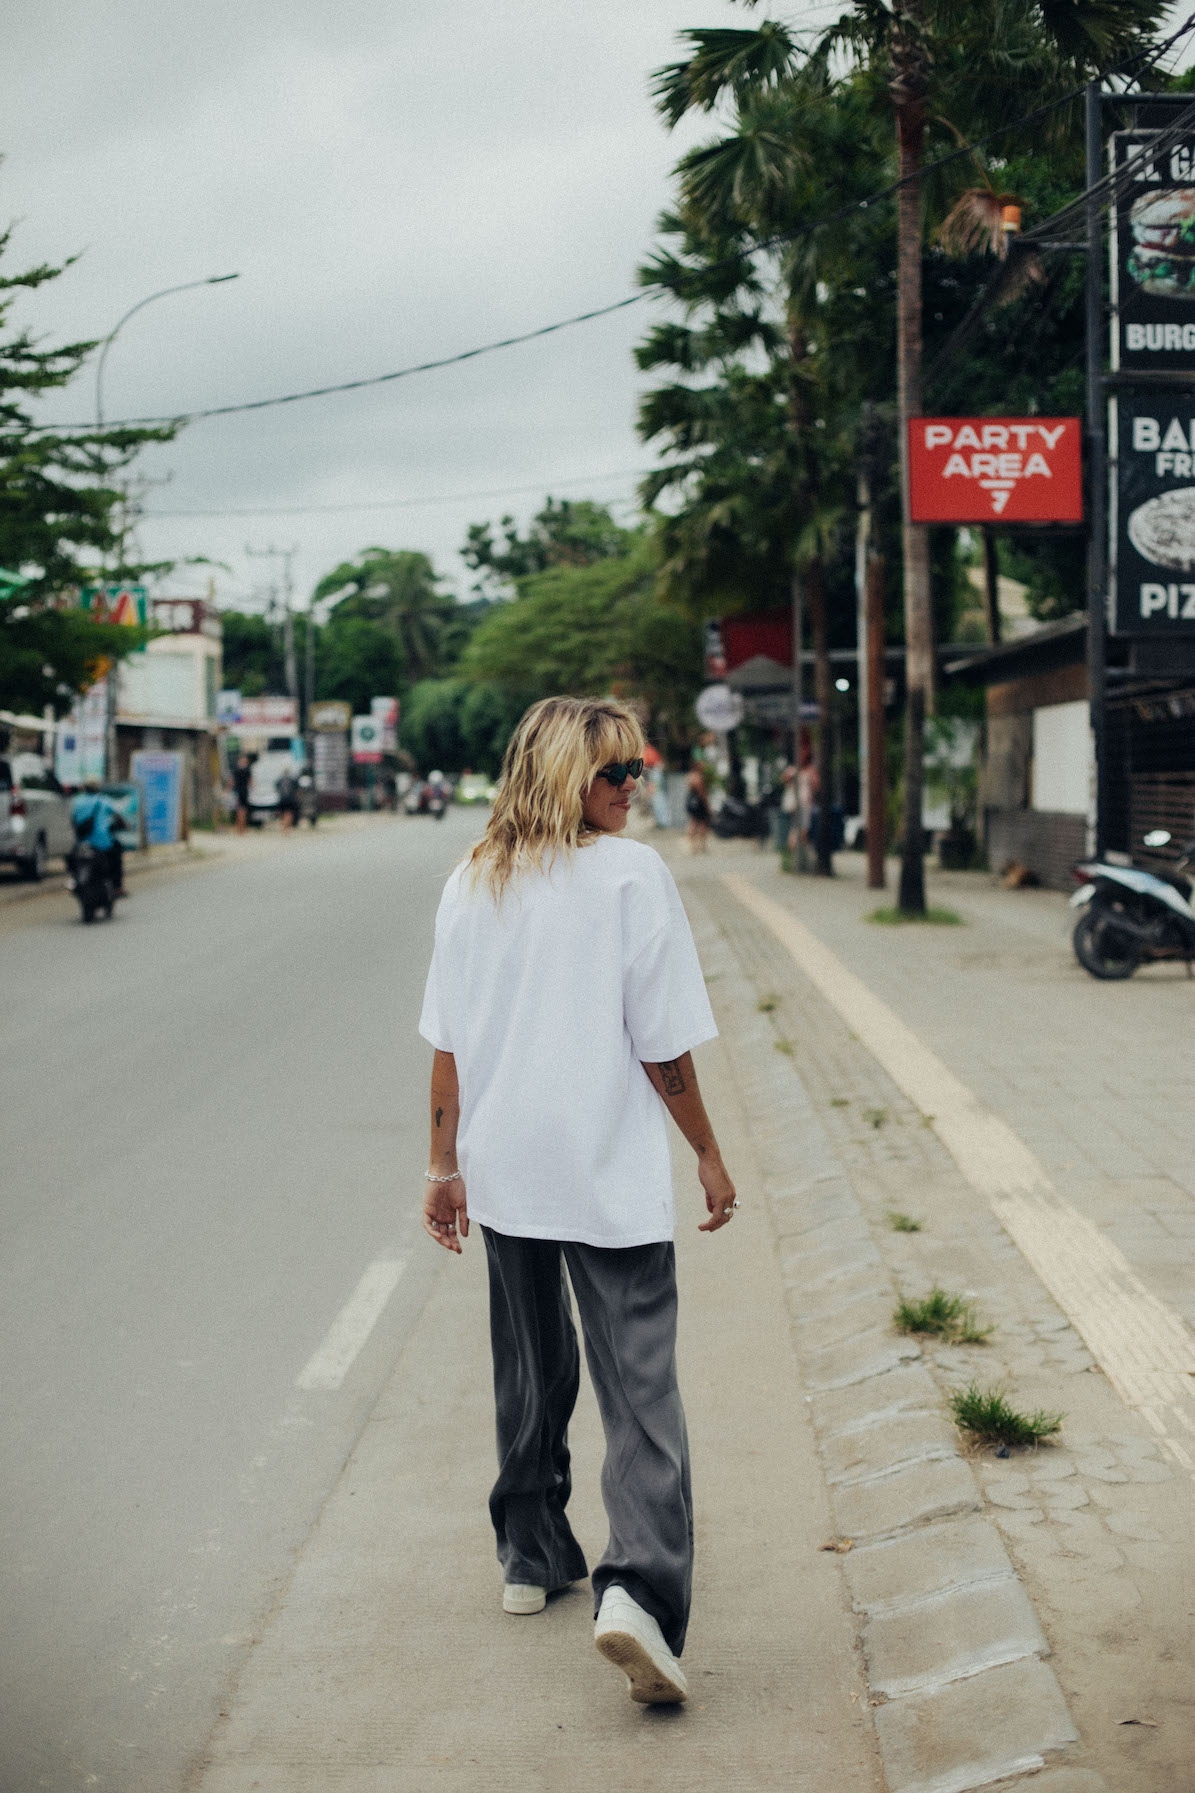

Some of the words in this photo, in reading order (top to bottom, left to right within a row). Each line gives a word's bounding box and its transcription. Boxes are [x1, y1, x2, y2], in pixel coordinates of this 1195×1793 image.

[1170, 143, 1195, 181] G
[1126, 323, 1195, 350] BURG
[924, 424, 1066, 450] PARTY
[1133, 416, 1195, 452] BA
[942, 452, 1053, 479] AREA
[1156, 451, 1195, 478] FR
